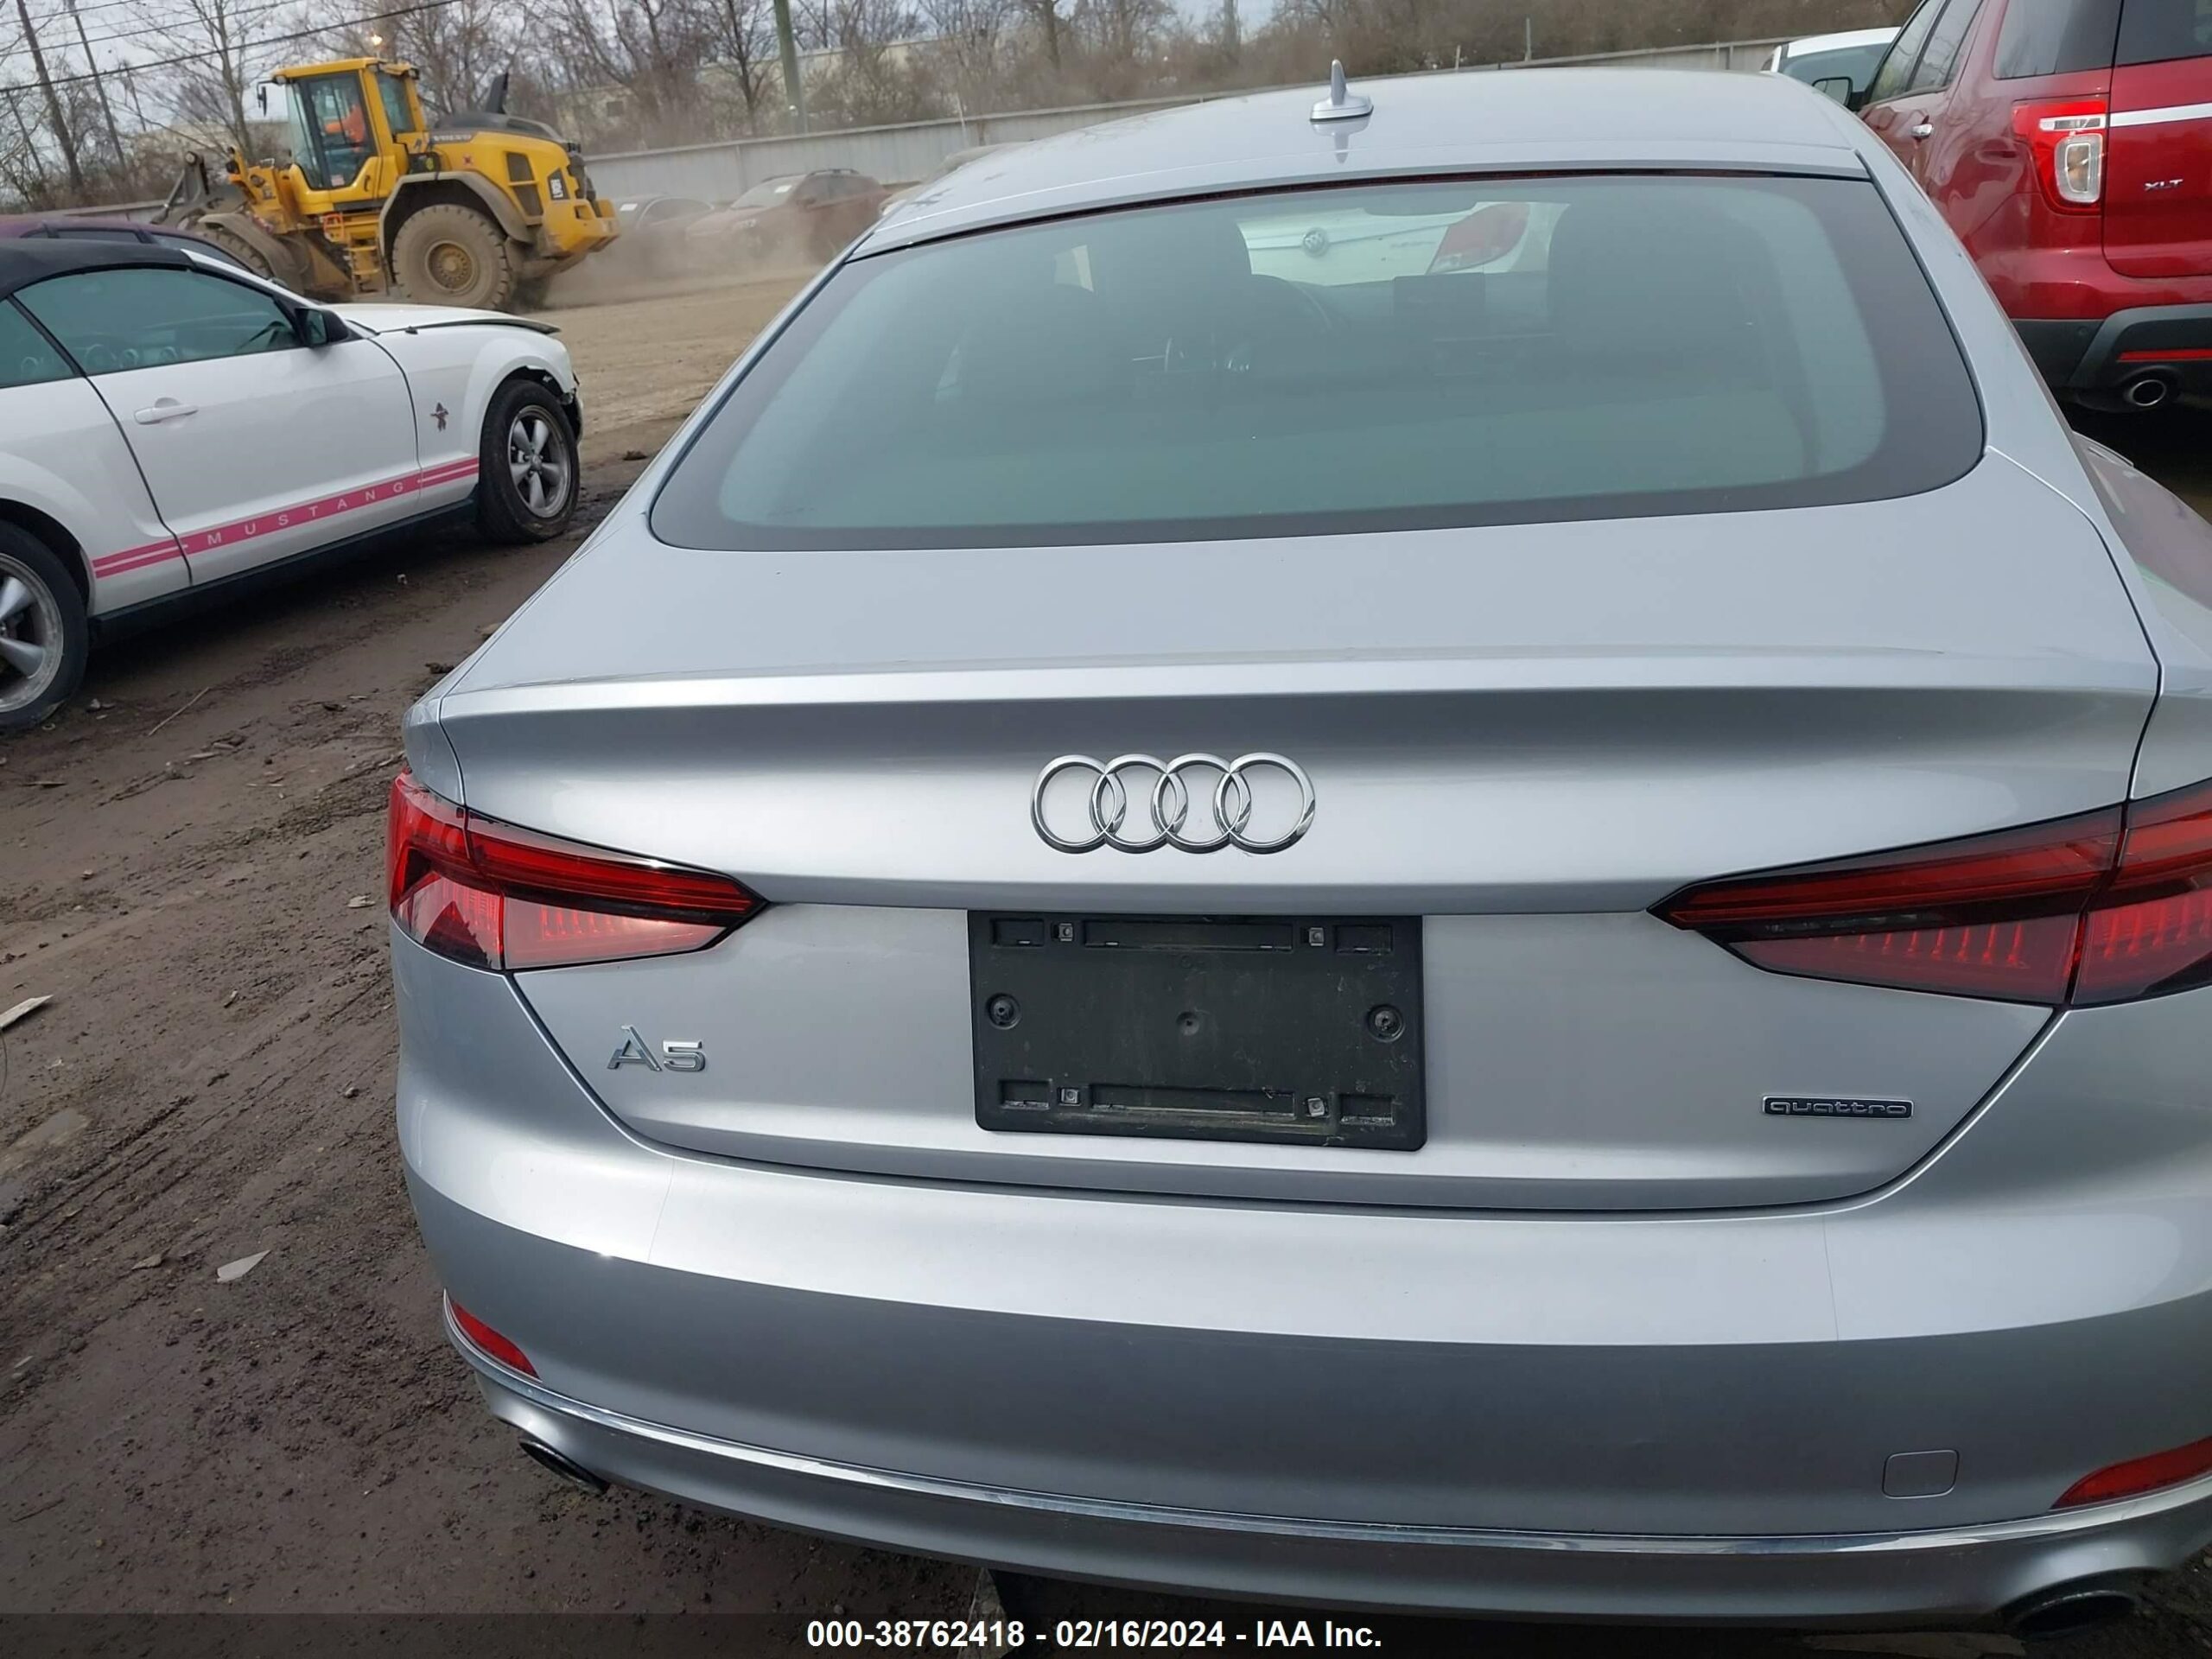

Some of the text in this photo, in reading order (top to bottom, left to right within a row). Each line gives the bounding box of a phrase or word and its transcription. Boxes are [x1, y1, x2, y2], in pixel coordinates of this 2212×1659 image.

[2144, 178, 2183, 191] XLT
[207, 481, 405, 546] MUSTANG
[607, 1025, 706, 1072] A5
[1770, 1101, 1907, 1115] quattro
